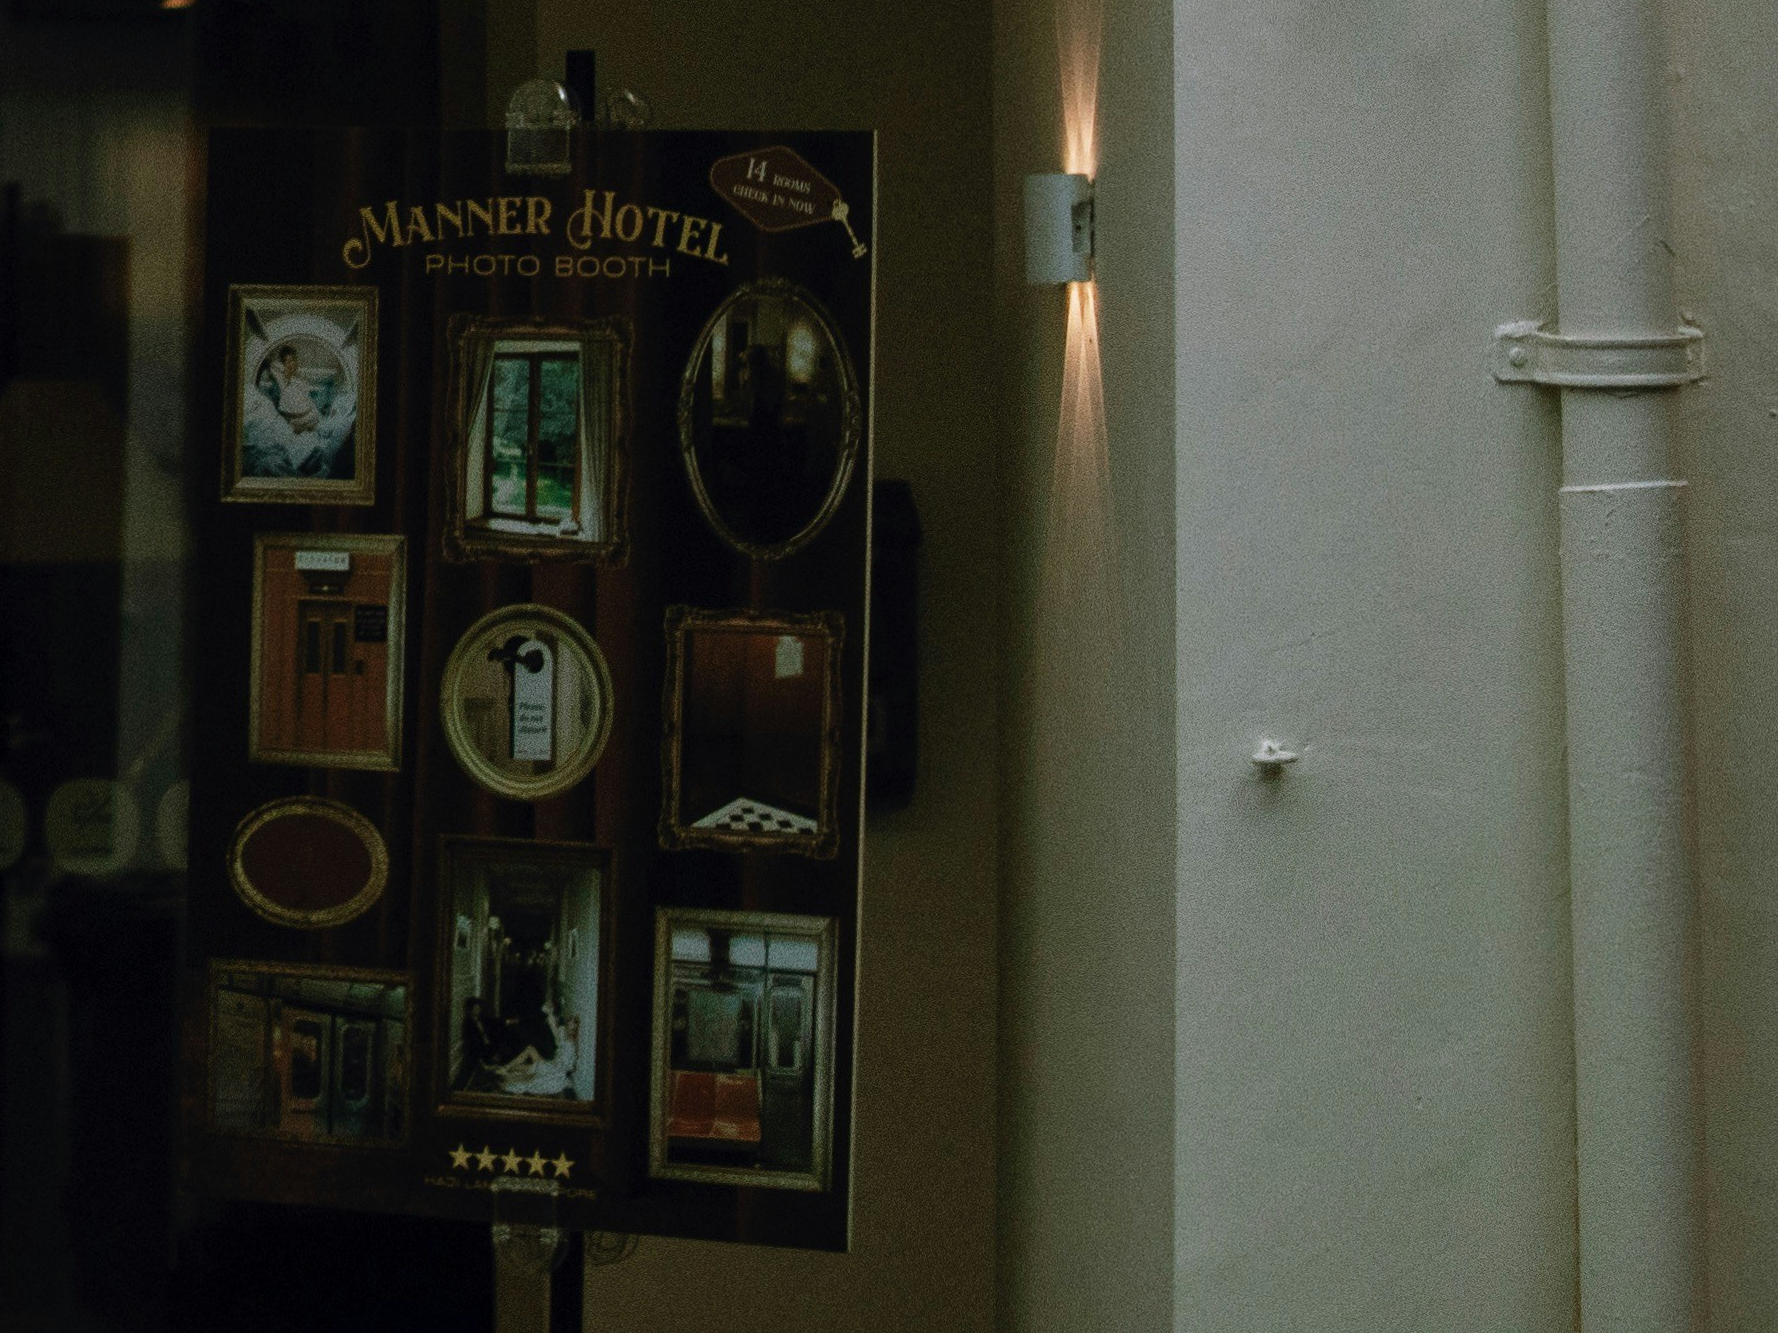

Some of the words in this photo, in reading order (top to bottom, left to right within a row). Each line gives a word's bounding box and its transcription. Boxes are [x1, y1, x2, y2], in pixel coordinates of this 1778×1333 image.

[745, 156, 768, 183] 14
[773, 173, 812, 195] ROOMS
[732, 183, 770, 204] CHECK
[772, 192, 786, 207] IN
[787, 197, 816, 216] NOW
[342, 195, 553, 270] MANNER
[566, 189, 730, 266] HOTEL
[425, 253, 541, 277] PHOTO
[554, 255, 671, 278] BOOTH
